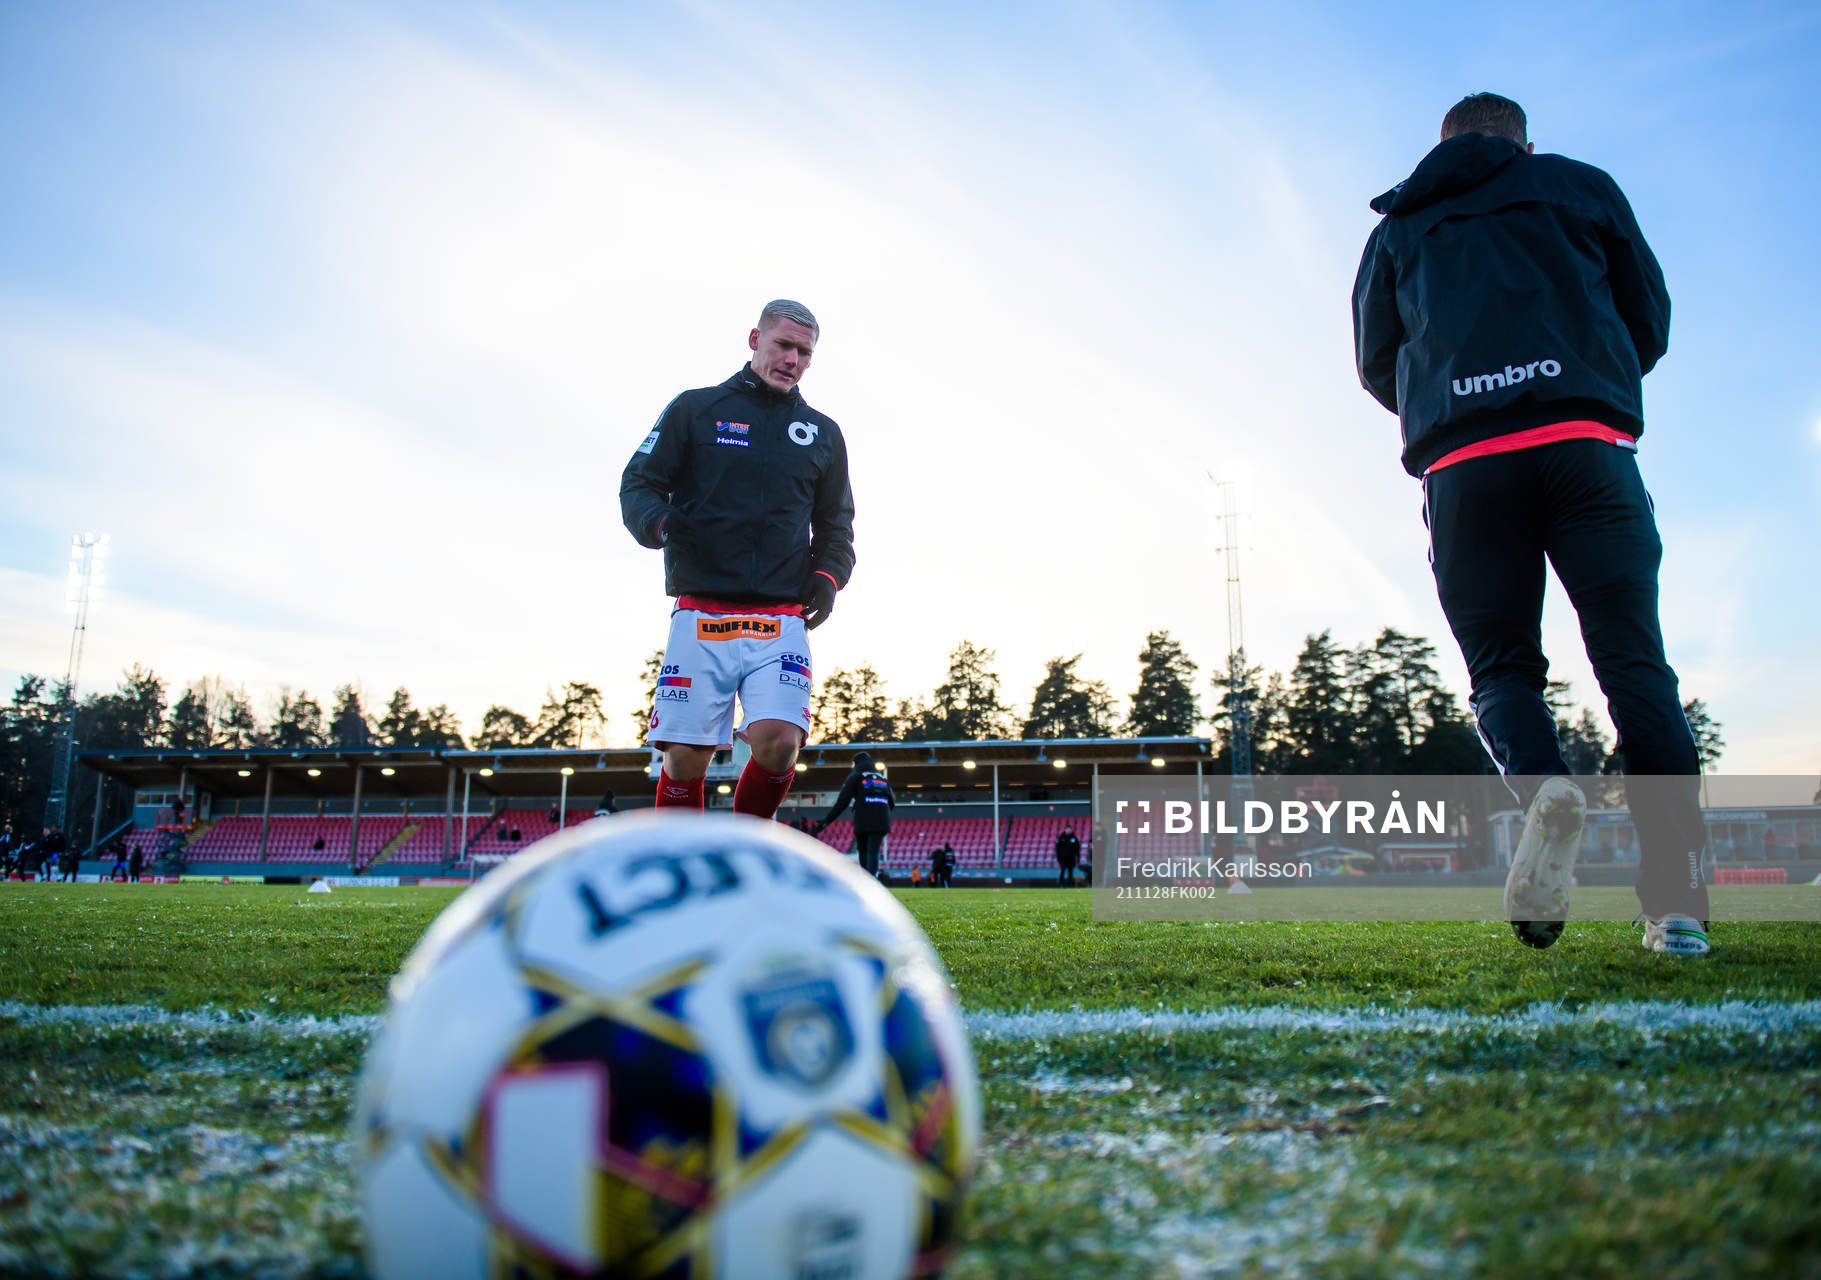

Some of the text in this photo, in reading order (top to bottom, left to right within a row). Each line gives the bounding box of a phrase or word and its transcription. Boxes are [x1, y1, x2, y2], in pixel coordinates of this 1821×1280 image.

[1452, 358, 1562, 396] umbro
[702, 620, 776, 634] UNIFLEX
[780, 654, 810, 667] CEOS
[1688, 851, 1700, 889] umbro
